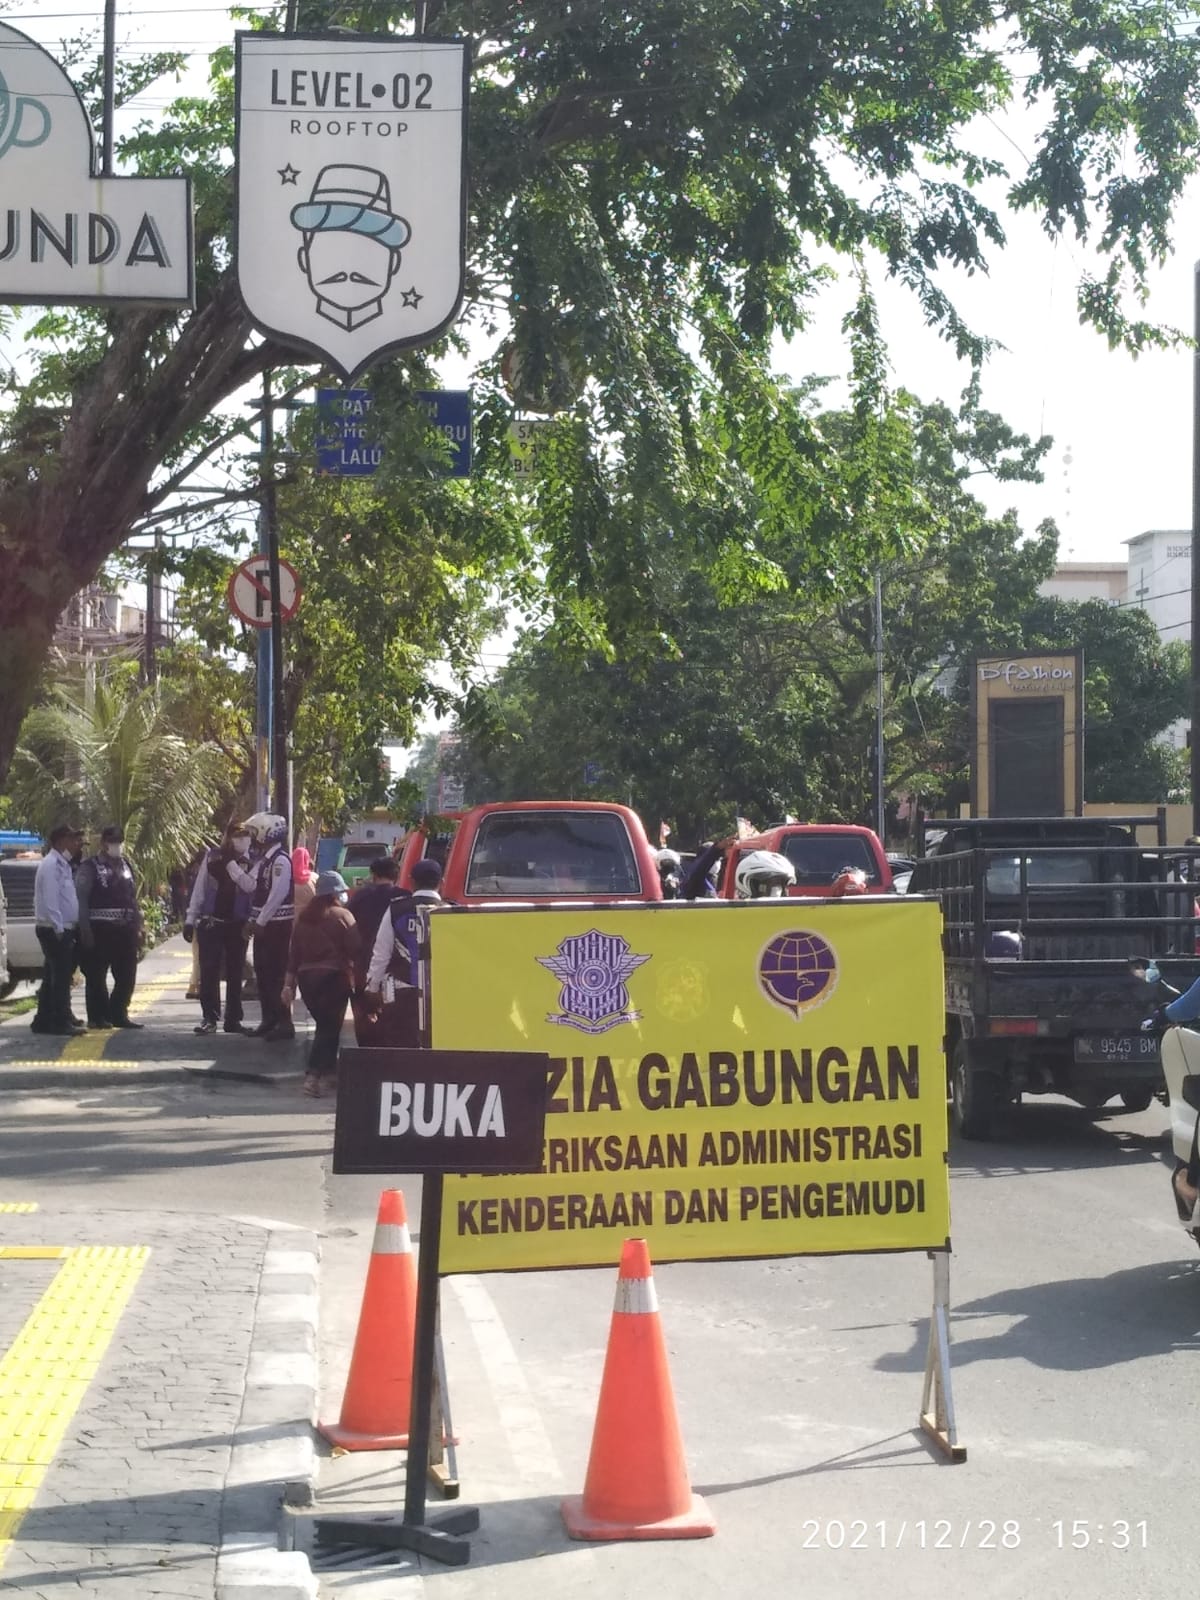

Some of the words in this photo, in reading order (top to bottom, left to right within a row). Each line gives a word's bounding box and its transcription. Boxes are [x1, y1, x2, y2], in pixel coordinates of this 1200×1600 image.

[290, 119, 409, 137] ROOFTOP
[340, 449, 382, 465] LALU
[1100, 1037, 1132, 1054] 9545
[1139, 1037, 1157, 1054] BM
[637, 1045, 920, 1112] GABUNGAN
[379, 1081, 506, 1138] BUKA
[698, 1123, 922, 1168] ADMINISTRASI
[457, 1190, 653, 1236] KENDERAAN
[664, 1187, 729, 1225] DAN
[740, 1179, 926, 1222] PENGEMUDI
